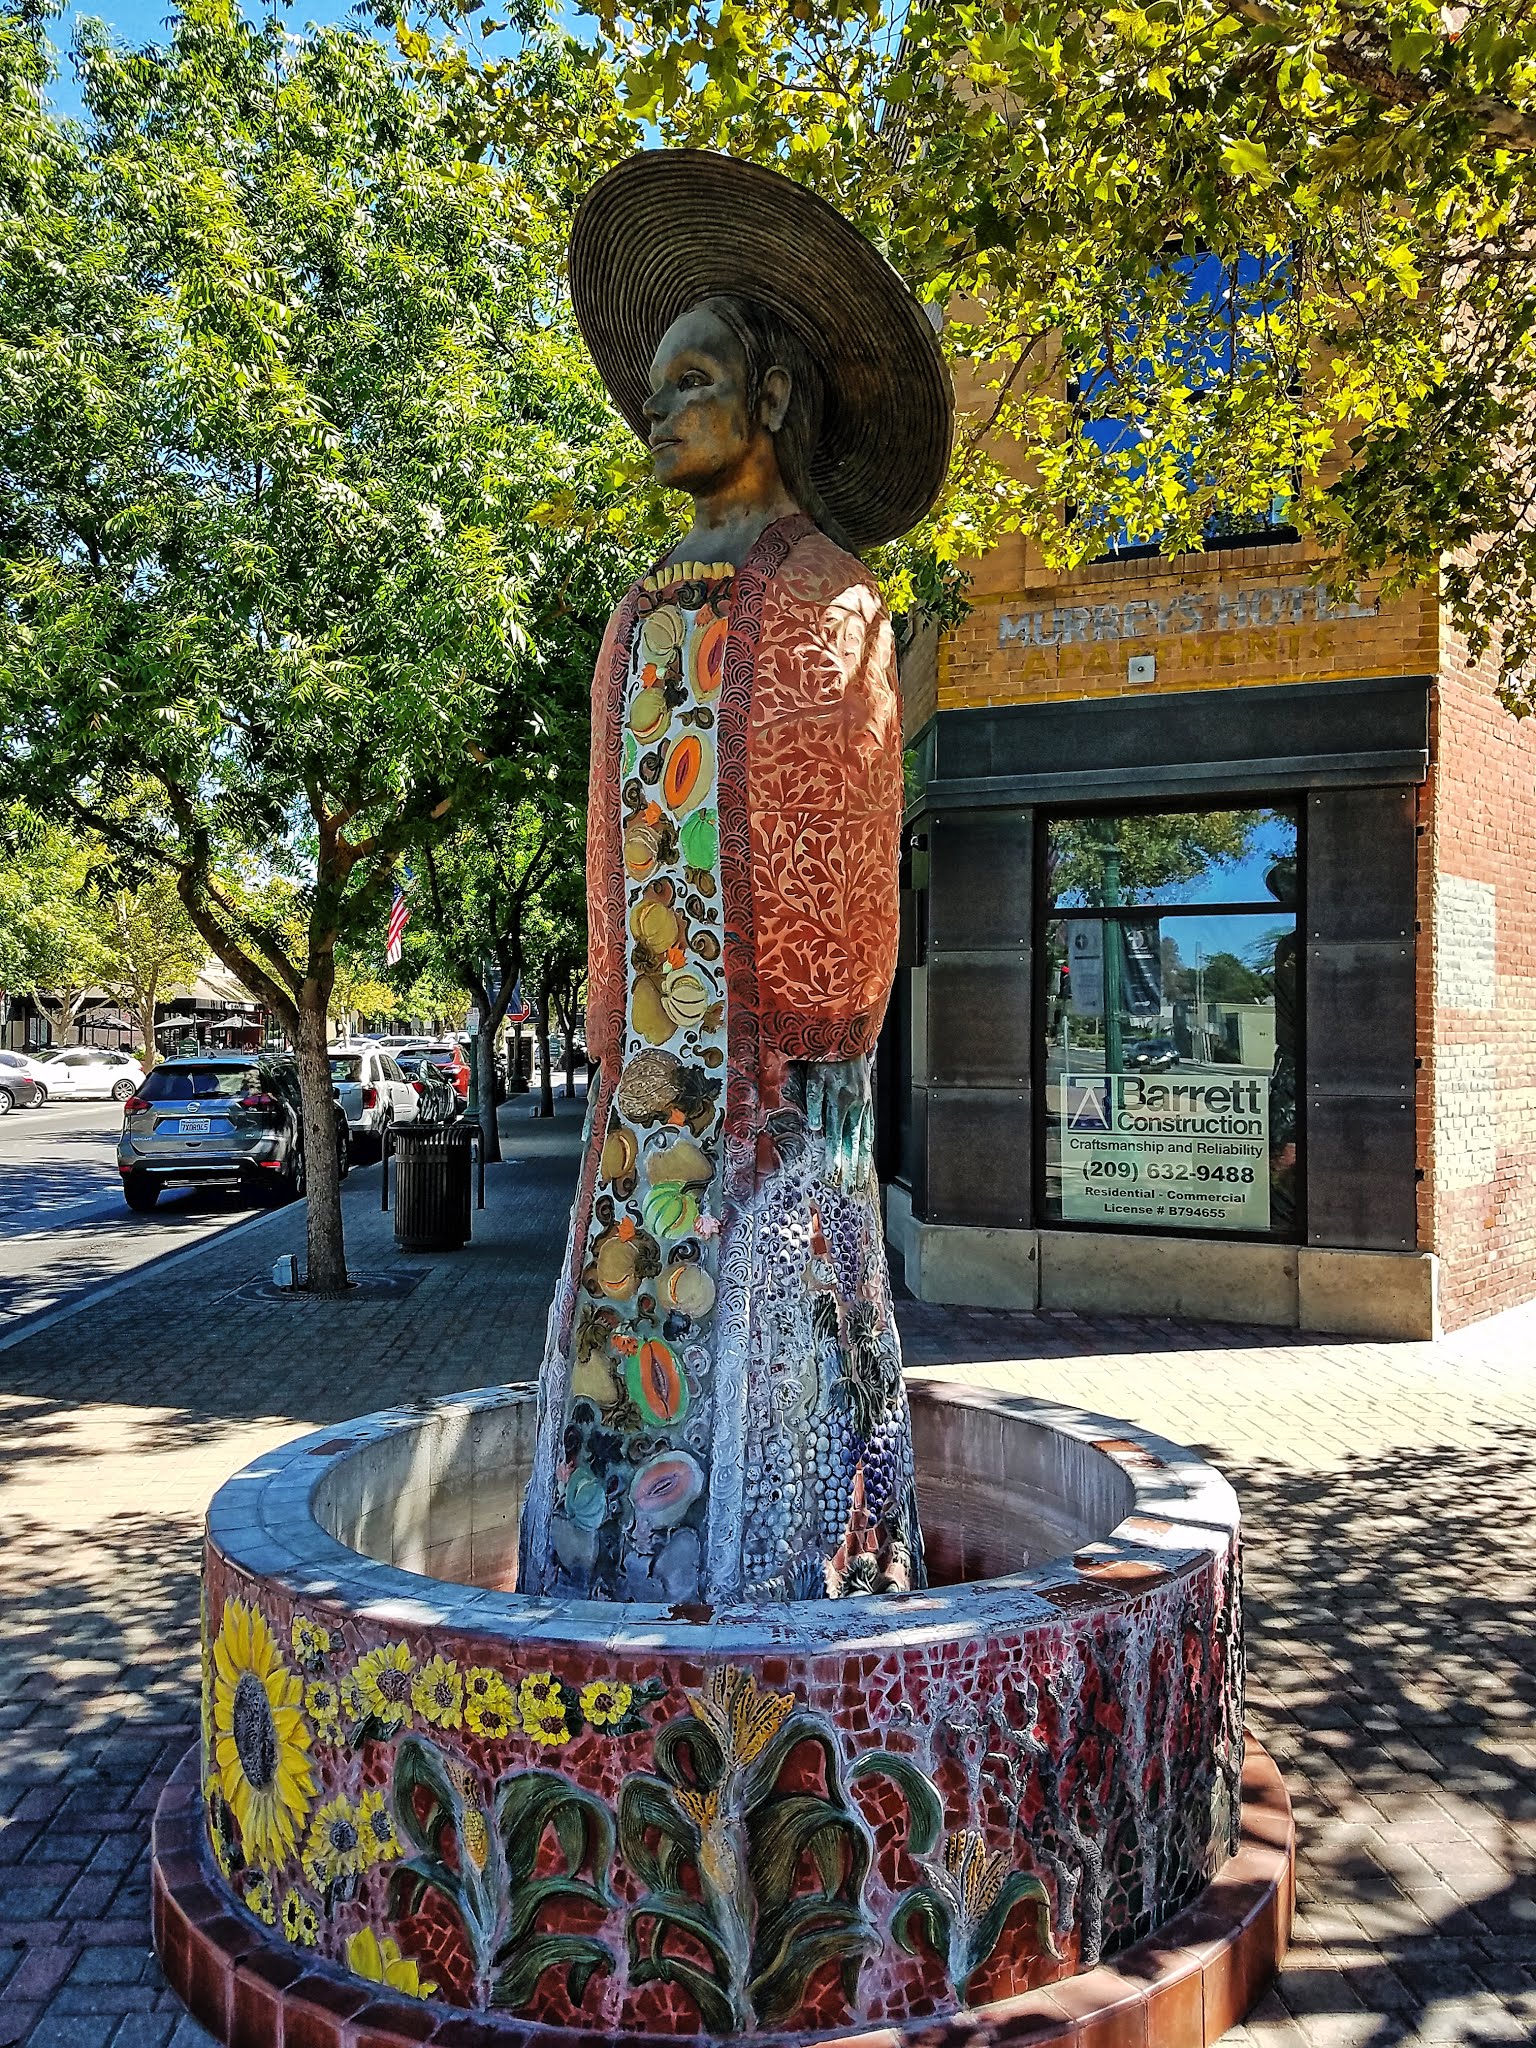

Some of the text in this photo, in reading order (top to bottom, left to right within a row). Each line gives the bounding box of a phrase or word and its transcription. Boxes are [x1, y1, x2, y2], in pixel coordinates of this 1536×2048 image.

[1117, 1076, 1262, 1114] Barrett
[1117, 1112, 1263, 1135] Construction
[1070, 1138, 1263, 1158] Craftsmanship and Reliability
[1082, 1161, 1255, 1183] (209) 632-9488
[1085, 1186, 1155, 1199] Residential
[1167, 1190, 1246, 1203] Commercial
[1104, 1203, 1153, 1215] License
[1156, 1206, 1165, 1215] #
